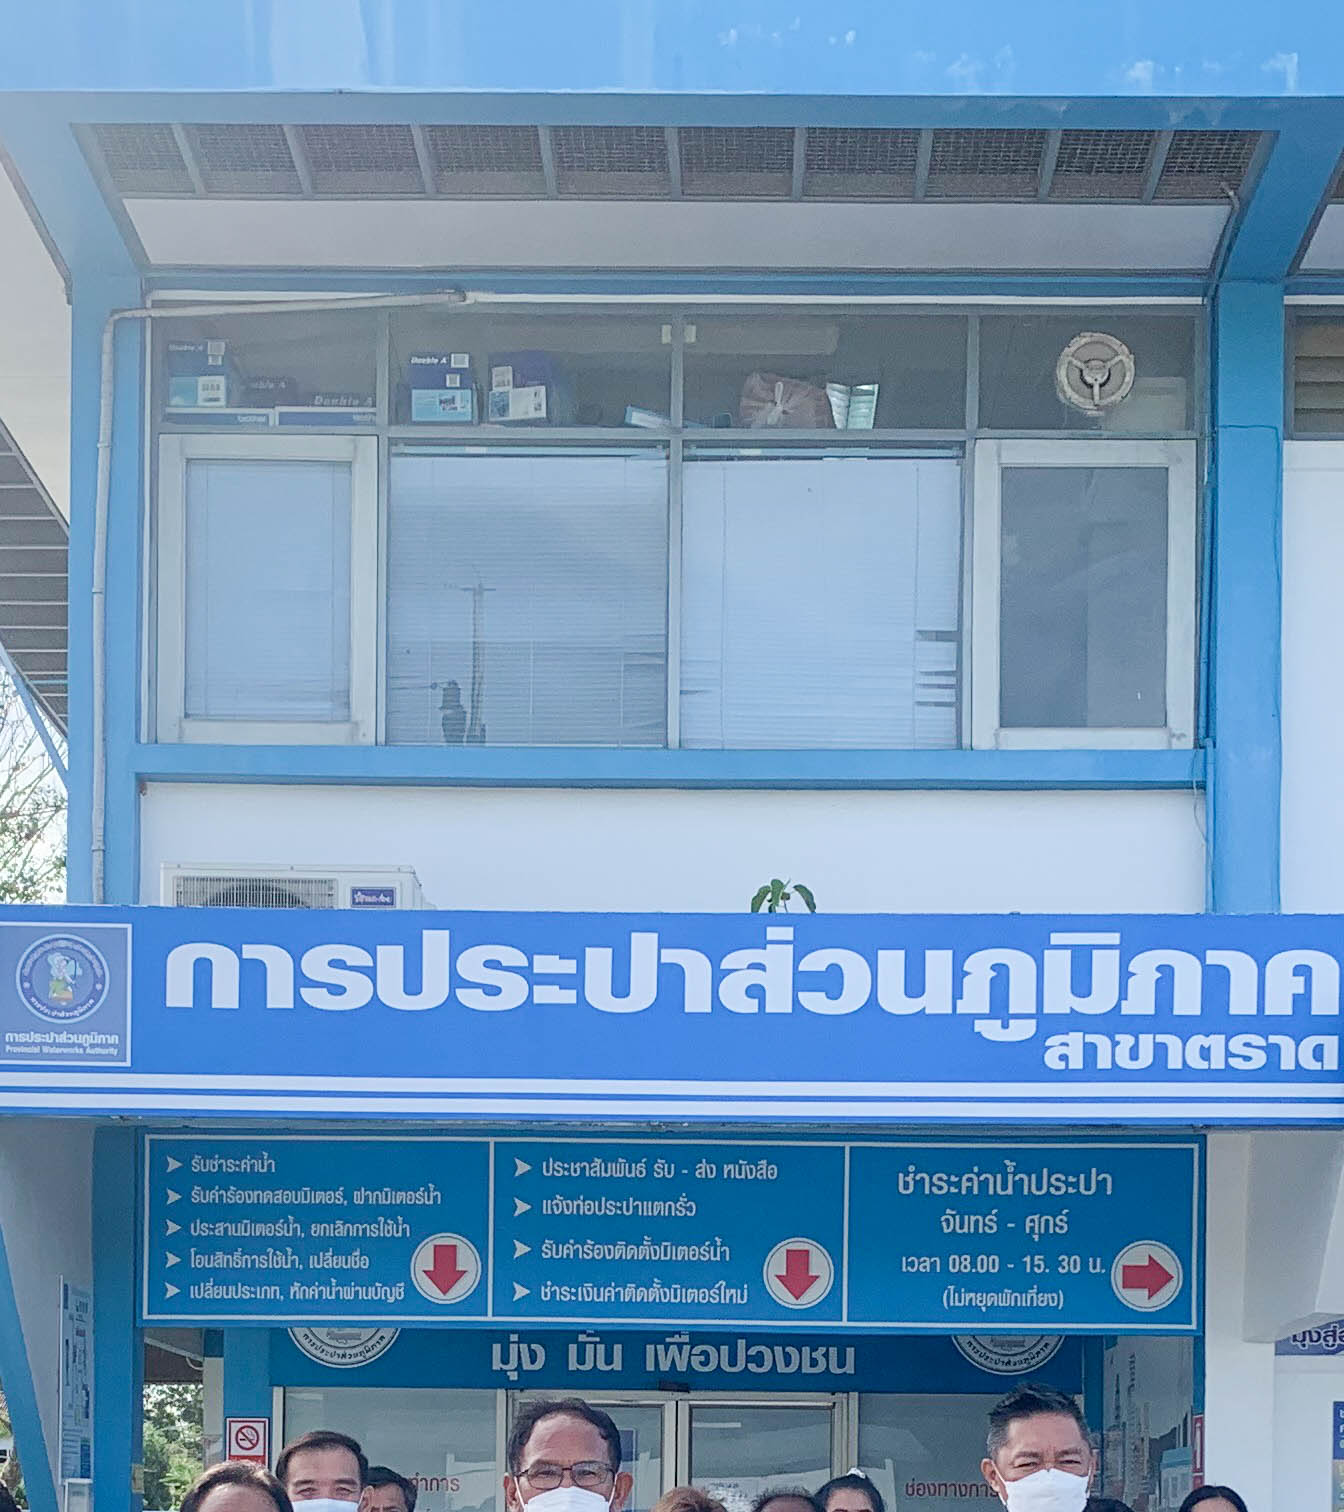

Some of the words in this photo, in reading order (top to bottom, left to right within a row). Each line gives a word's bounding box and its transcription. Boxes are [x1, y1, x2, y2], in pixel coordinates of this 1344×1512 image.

[411, 356, 439, 365] Double
[314, 395, 359, 407] Double
[365, 396, 373, 407] A
[166, 927, 1340, 1042] การประปาส่วนภูมิภาค
[1044, 1031, 1340, 1072] สาขาตราด
[191, 1151, 276, 1173] รับชำระค่าน้ำ
[542, 1157, 647, 1178] ประชาสัมพันธ์
[654, 1158, 675, 1179] รับ
[695, 1158, 716, 1179] ส่ง
[723, 1159, 778, 1180] หนังสือ
[898, 1159, 1113, 1196] ชำระค่าน้ำประปา
[353, 1183, 442, 1205] ฝากมิเตอร์น้ำ
[542, 1192, 697, 1217] แจ้งท่อประปาแตกรั่ว
[311, 1215, 411, 1238] ยกเลิกการใช้น้ำ
[941, 1209, 998, 1234] จันทร์
[1025, 1209, 1069, 1242] ศุกร์
[309, 1249, 370, 1269] เปลี่ยนชื่อ
[541, 1235, 730, 1261] รับคำร้องติดตั้งมิเตอร์น้ำ
[901, 1256, 941, 1274] เวลา
[948, 1255, 1000, 1274] 08.00
[1088, 1257, 1106, 1274] น.
[289, 1278, 405, 1303] หักค่าน้ำผ่านบัญชี
[540, 1278, 748, 1304] ชำระเงินค่าติดตั้งมิเตอร์ใหม่
[942, 1285, 1064, 1312] (ไม่หยุดพักเที่ยง)
[491, 1333, 546, 1380] มุ่ง
[568, 1330, 623, 1371] มั่น
[645, 1331, 856, 1374] เพื่อปวงชน
